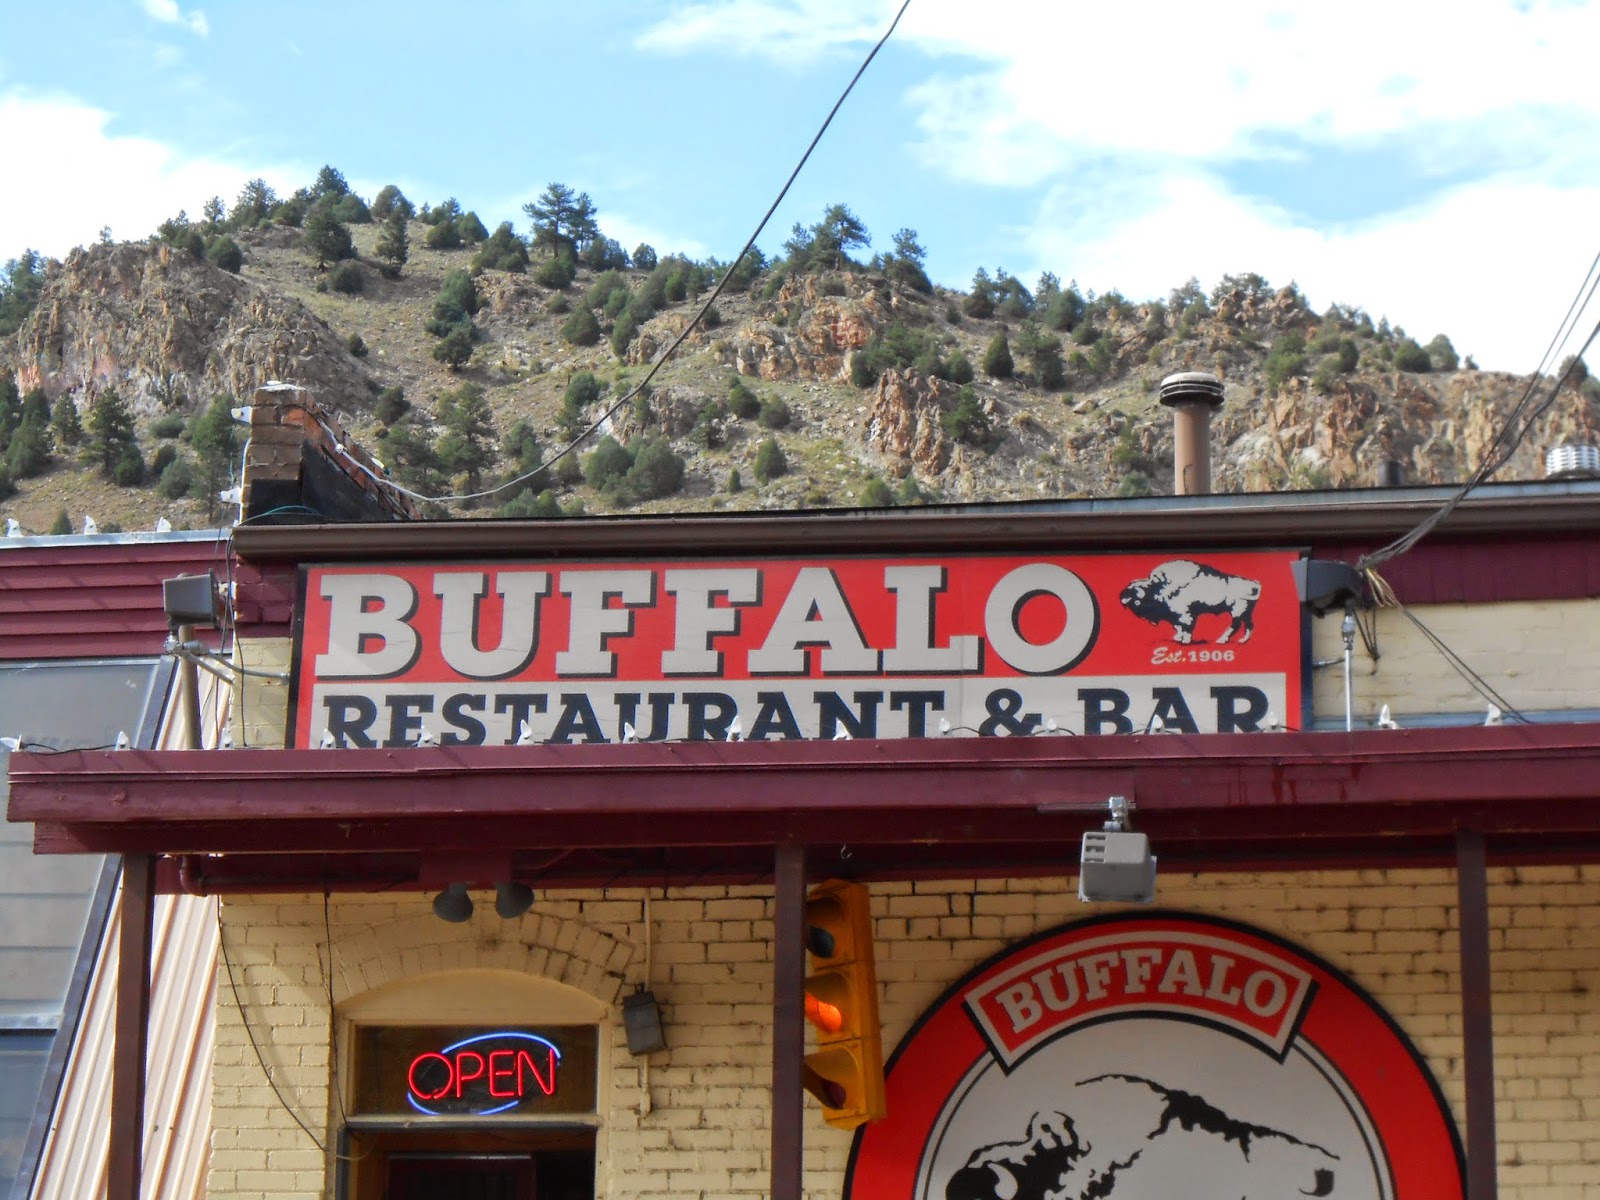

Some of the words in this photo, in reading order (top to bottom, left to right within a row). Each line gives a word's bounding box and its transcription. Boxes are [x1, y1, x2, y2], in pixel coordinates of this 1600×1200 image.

[314, 562, 1099, 680] BUFFALO
[1151, 646, 1186, 664] Est.
[1188, 650, 1235, 662] 1906
[322, 690, 945, 748] RESTAURANT
[979, 688, 1042, 737] &
[1077, 686, 1269, 735] BAR
[995, 948, 1288, 1034] BUFFALO
[408, 1049, 555, 1099] OPEN
